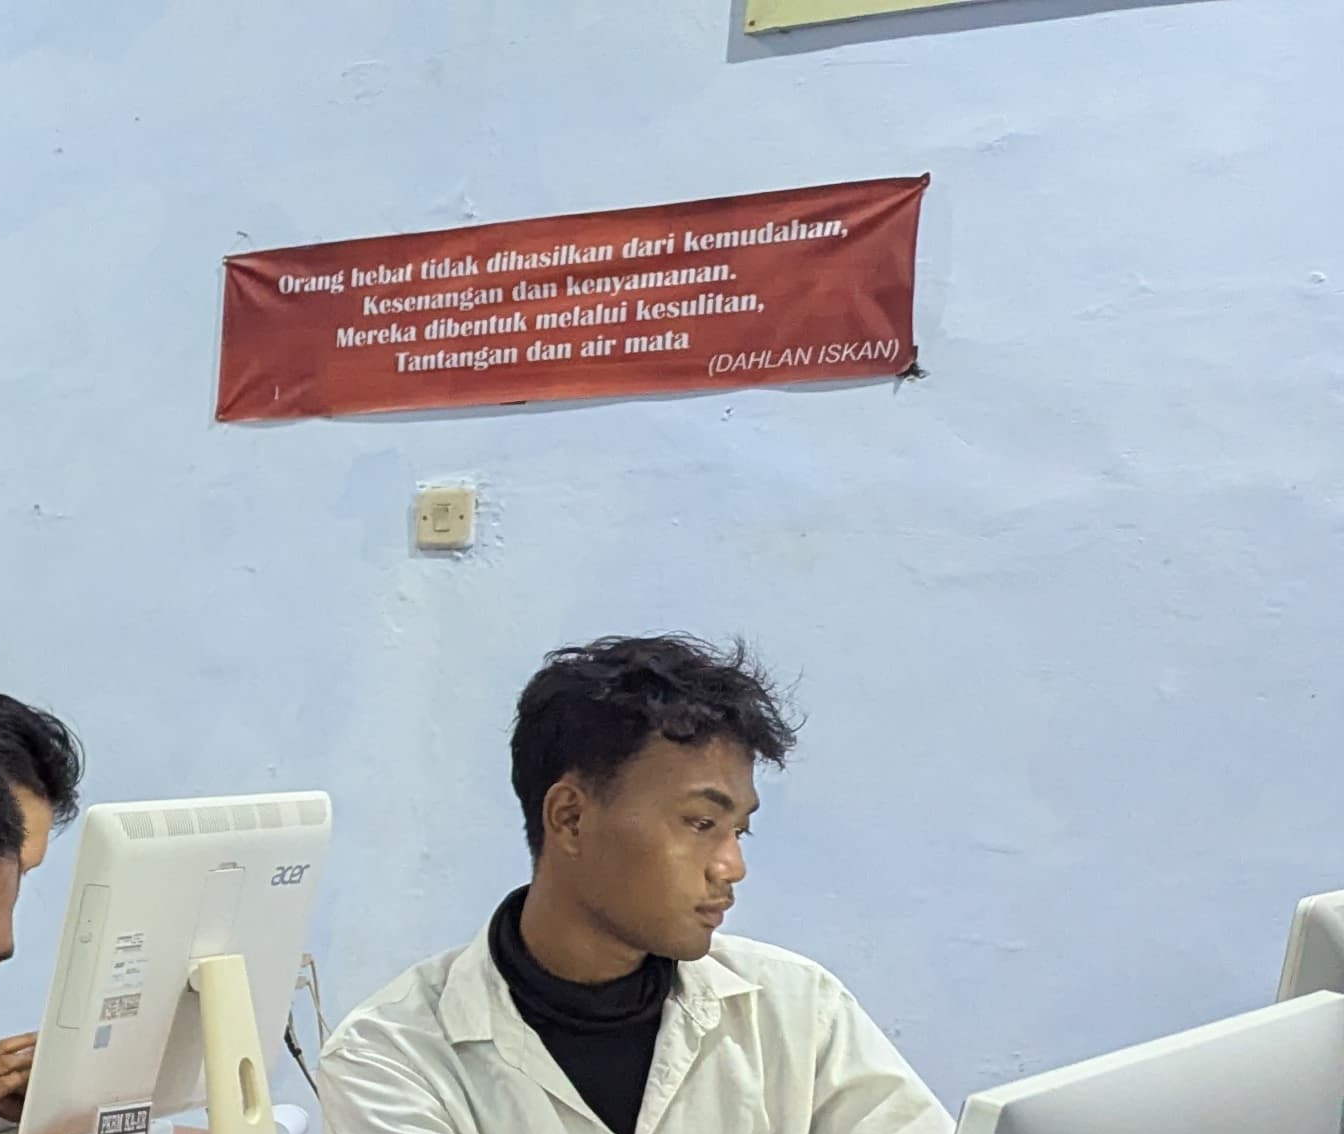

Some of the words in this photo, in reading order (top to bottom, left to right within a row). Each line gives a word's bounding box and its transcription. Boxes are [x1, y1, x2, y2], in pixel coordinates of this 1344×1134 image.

[278, 269, 345, 295] Orang
[350, 263, 413, 288] hebat
[420, 255, 479, 280] tidak
[486, 243, 613, 273] dihasilkan
[622, 233, 675, 259] dari
[683, 218, 849, 252] kemudahan,
[363, 286, 504, 316] Kesenangan
[512, 280, 557, 301] dan
[566, 264, 737, 297] kenyamanan.
[336, 322, 417, 348] Mereka
[424, 311, 527, 340] dibentuk
[535, 303, 628, 330] melalui
[635, 292, 765, 321] kesulitan,
[394, 346, 518, 373] Tantangan
[526, 340, 572, 362] dan
[580, 335, 617, 358] air
[624, 330, 691, 354] mata
[708, 346, 813, 377] (DAHLAN
[817, 338, 900, 364] ISKAN)
[271, 863, 311, 886] acer
